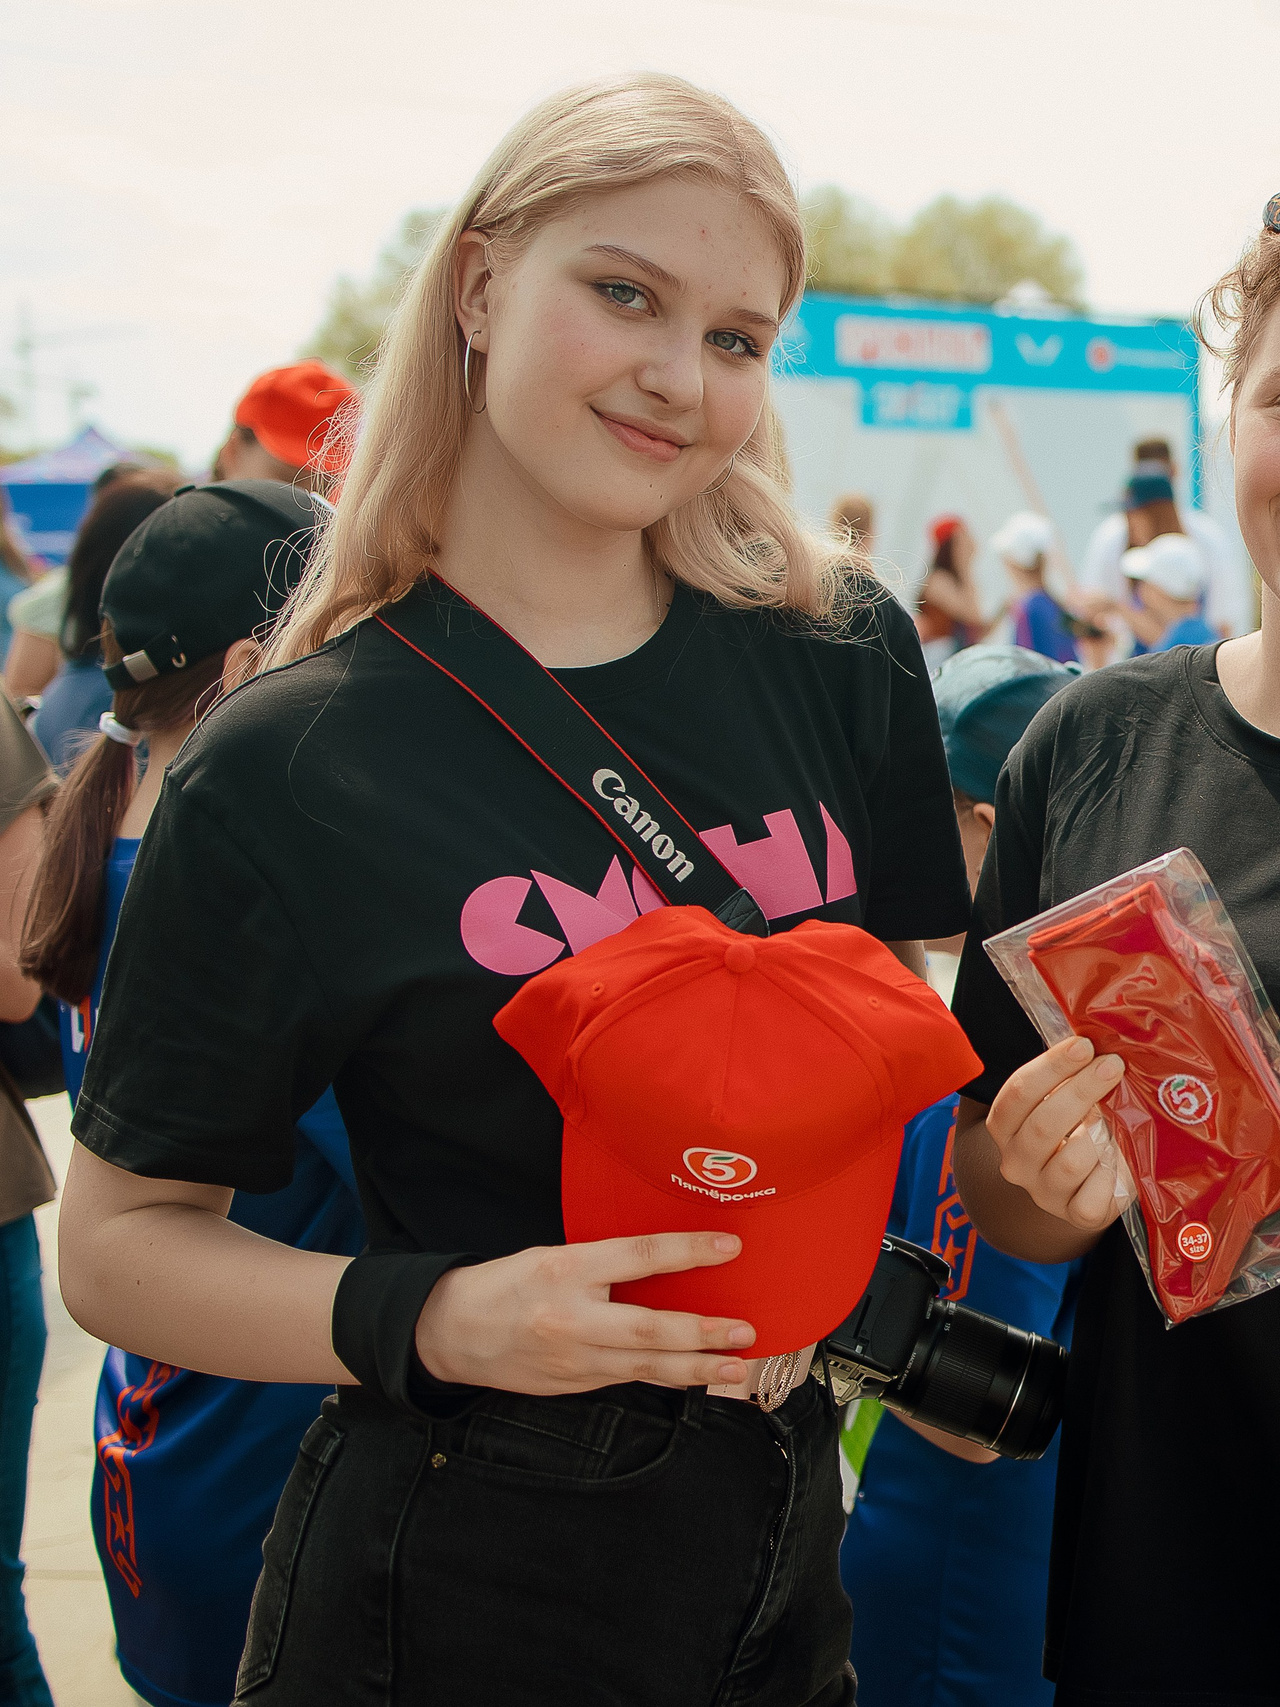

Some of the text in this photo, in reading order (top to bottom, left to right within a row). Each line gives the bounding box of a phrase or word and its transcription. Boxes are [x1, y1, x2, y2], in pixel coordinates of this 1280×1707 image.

[592, 768, 695, 882] Canon
[1170, 1077, 1199, 1116] 5
[702, 1153, 739, 1181] 5
[670, 1173, 776, 1202] Пятёрочка
[1181, 1232, 1208, 1247] 34-37
[1189, 1245, 1205, 1254] size
